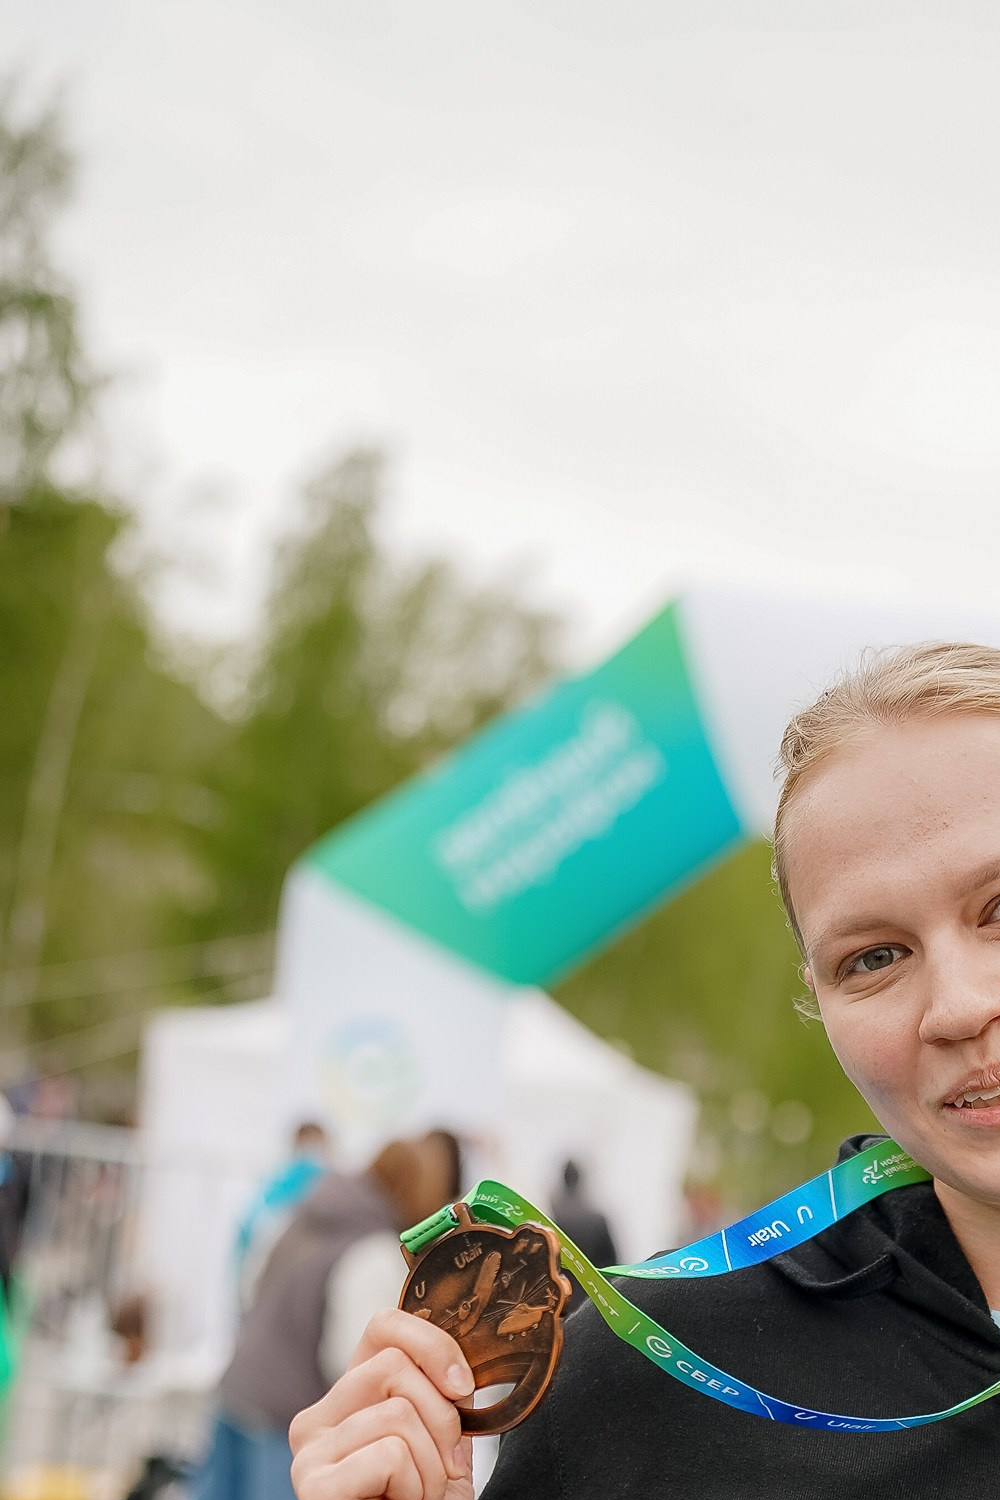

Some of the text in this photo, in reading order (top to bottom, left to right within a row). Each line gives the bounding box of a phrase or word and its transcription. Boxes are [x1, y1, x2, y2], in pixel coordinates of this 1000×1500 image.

[748, 1220, 791, 1247] Utair
[587, 1280, 620, 1317] лет
[676, 1360, 740, 1396] СБЕР
[827, 1420, 877, 1430] Utair
